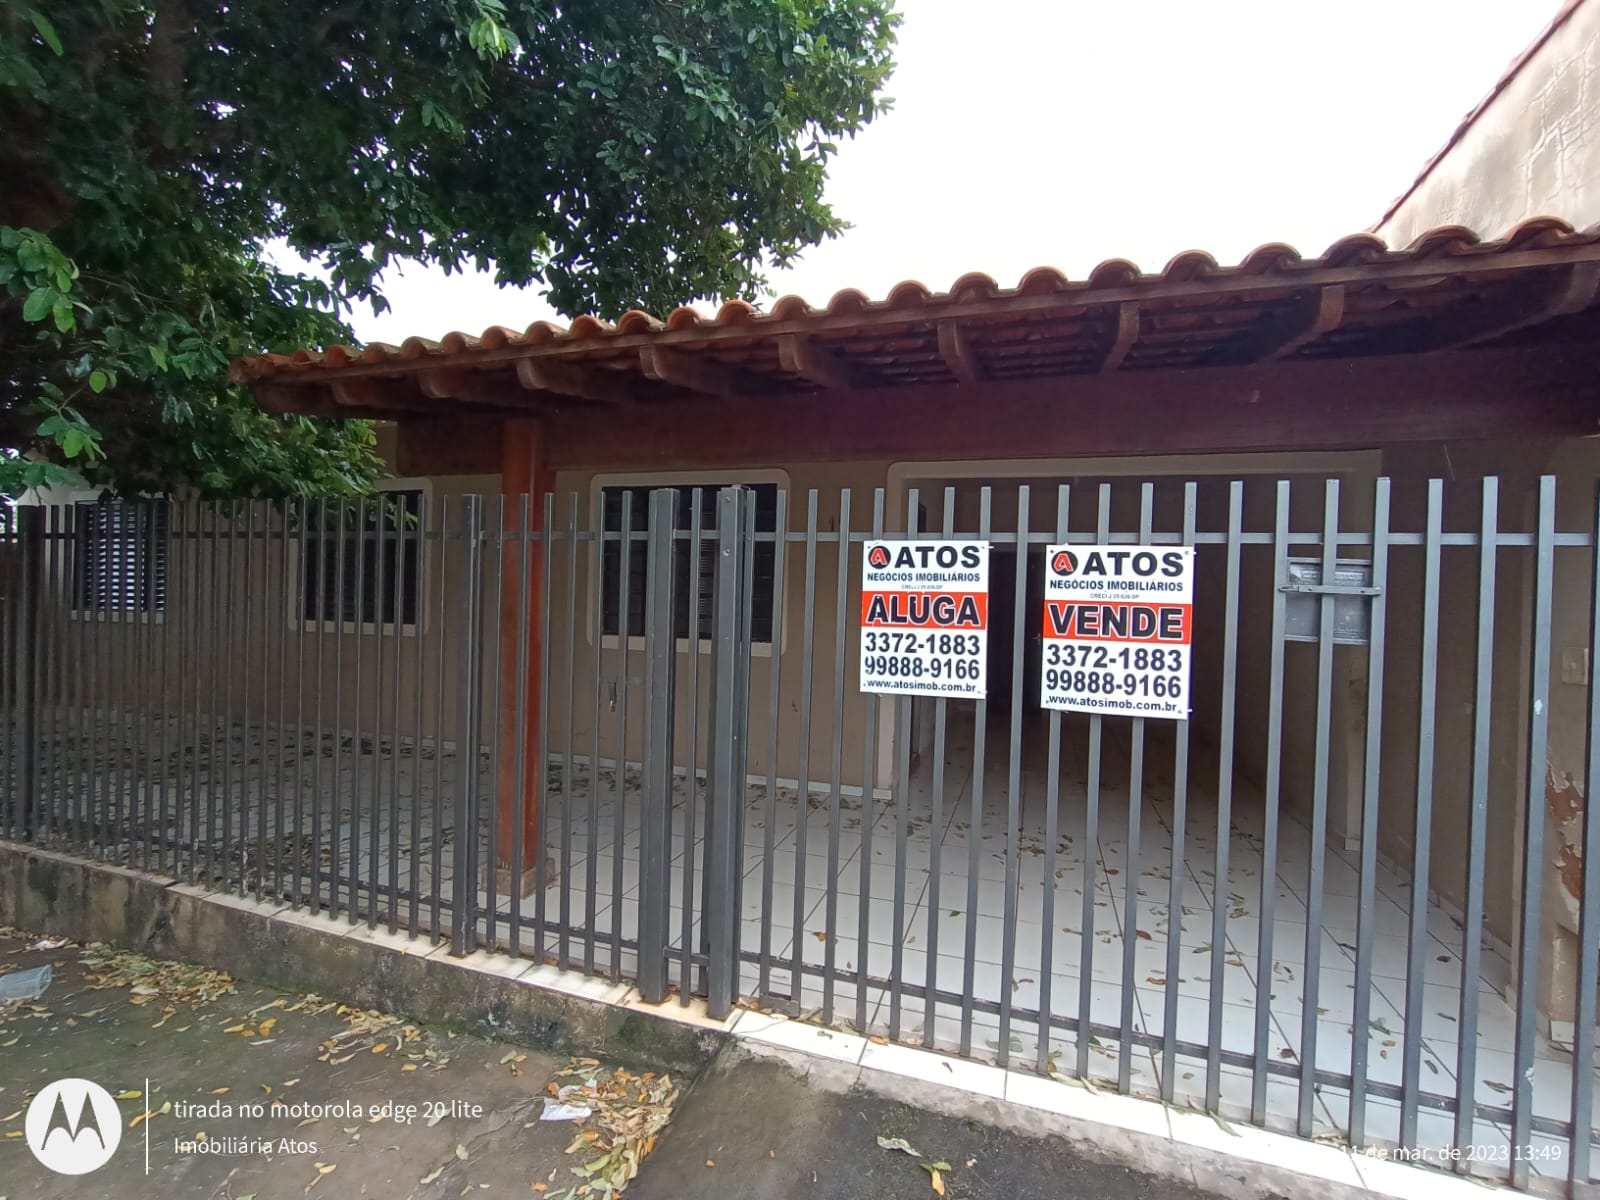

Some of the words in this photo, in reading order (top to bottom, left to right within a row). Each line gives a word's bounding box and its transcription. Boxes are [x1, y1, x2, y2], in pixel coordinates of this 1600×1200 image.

[894, 545, 981, 569] ATOS
[1082, 551, 1184, 577] ATOS
[867, 570, 913, 582] NEGÓCIOS
[916, 571, 981, 582] IMOBILIÁRIOS
[1050, 578, 1104, 590] NEGÓCIOS
[1107, 579, 1183, 592] IMOBILIÁRIOS
[866, 594, 981, 626] ALUGA
[1048, 603, 1185, 640] VENDE
[865, 631, 980, 656] 3372-1883
[864, 655, 980, 680] 99888-9166
[1046, 644, 1182, 672] 3372-1883
[867, 680, 976, 692] www.atosimob.com.br
[1046, 669, 1182, 698] 99888-9166
[1049, 695, 1177, 712] www.atosimob.com.br
